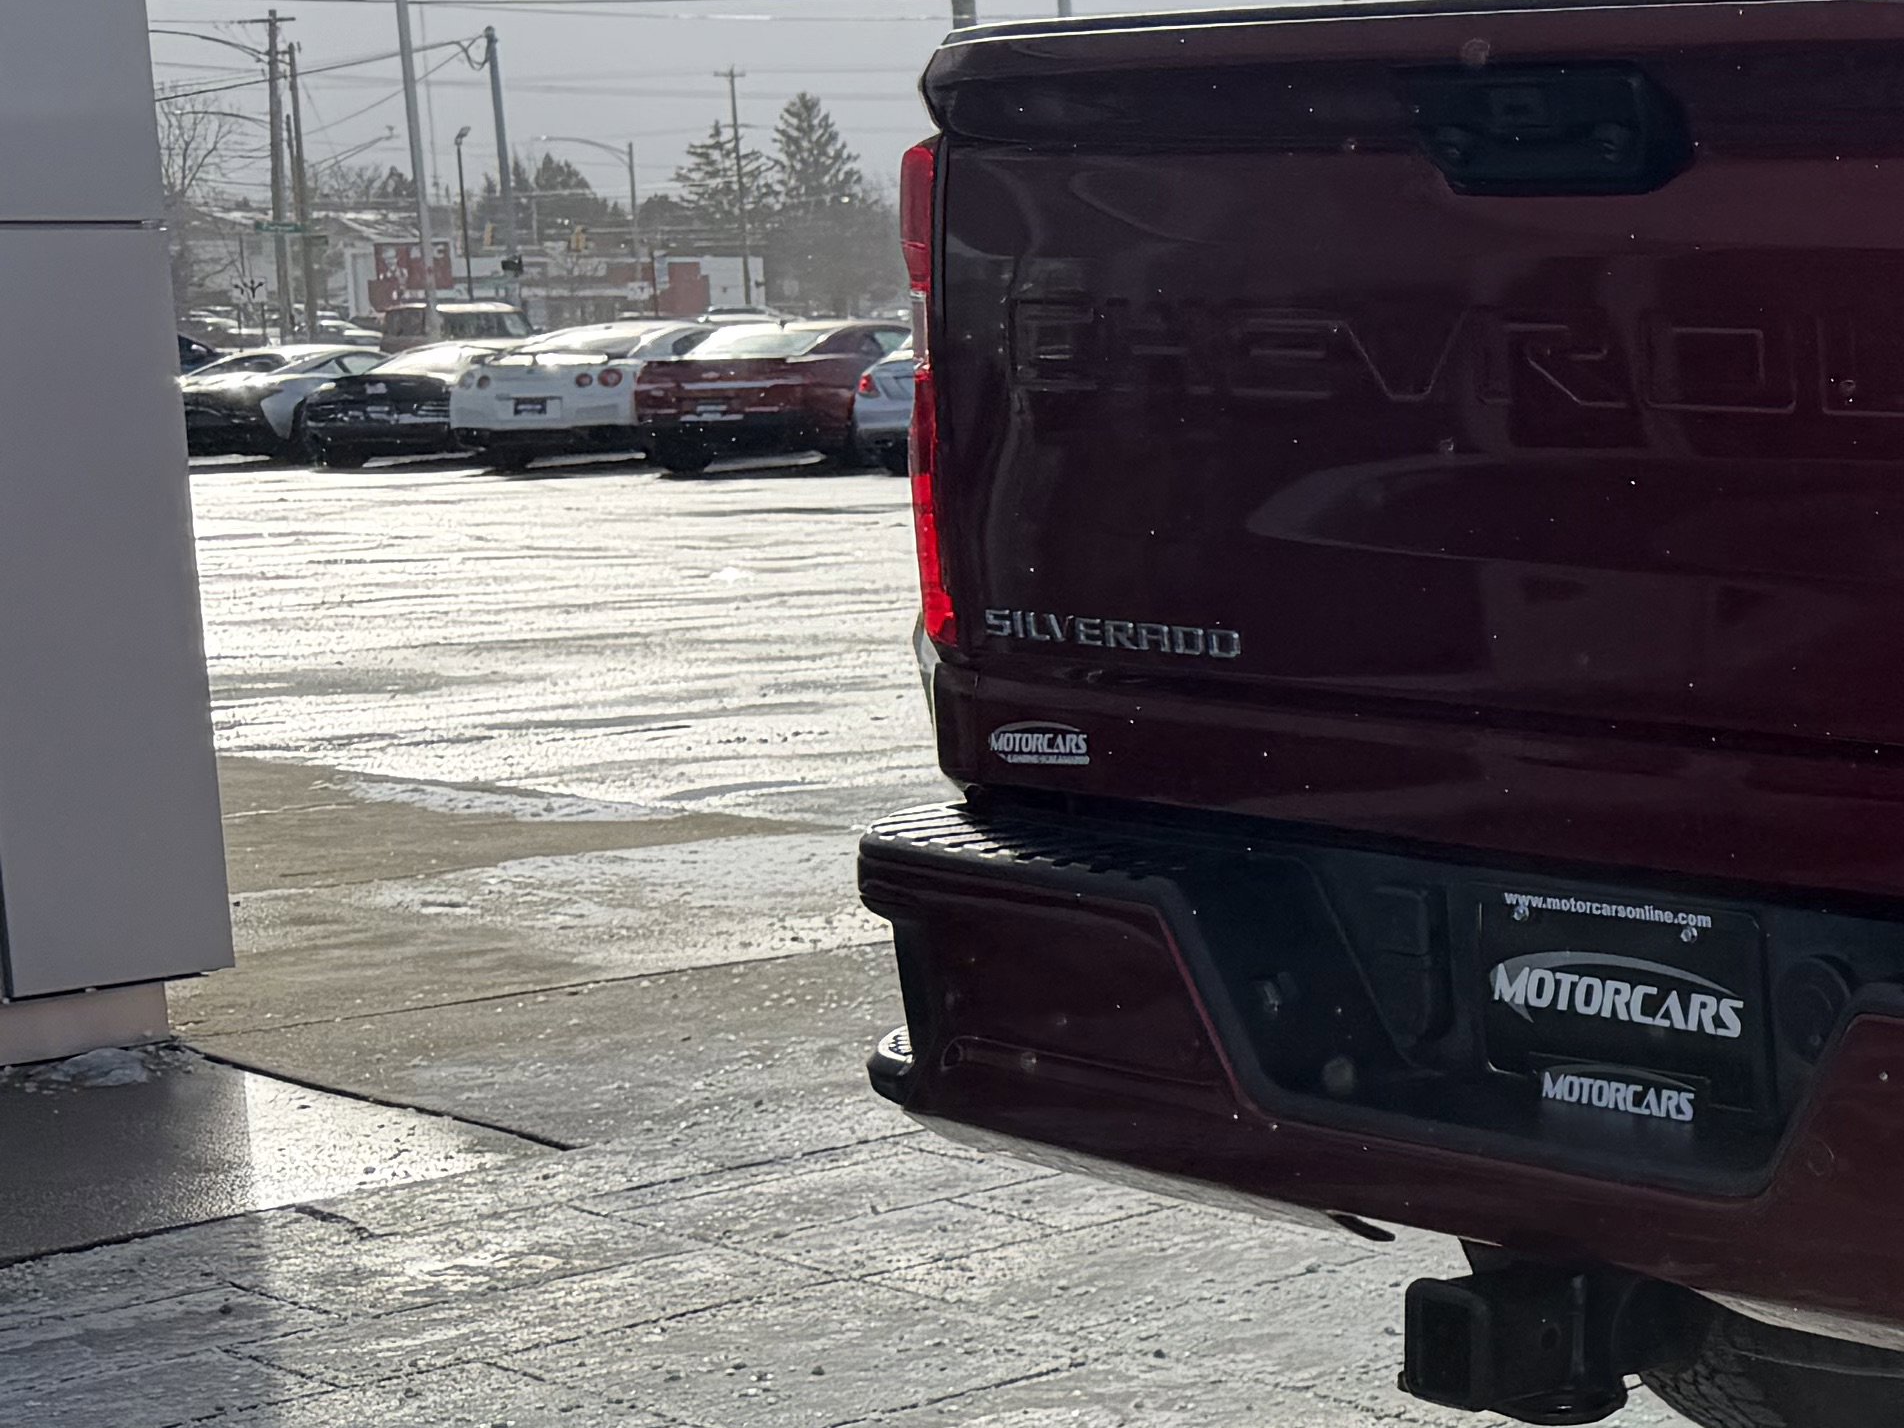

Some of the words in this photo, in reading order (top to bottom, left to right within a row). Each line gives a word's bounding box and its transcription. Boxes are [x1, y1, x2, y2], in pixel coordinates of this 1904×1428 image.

[984, 608, 1242, 659] SILVERADO
[990, 732, 1088, 754] MOTORCARS
[1503, 891, 1713, 929] www.motorcarsonline.com
[1493, 962, 1745, 1039] MOTORCARS
[1541, 1070, 1696, 1122] MOTORCARS
